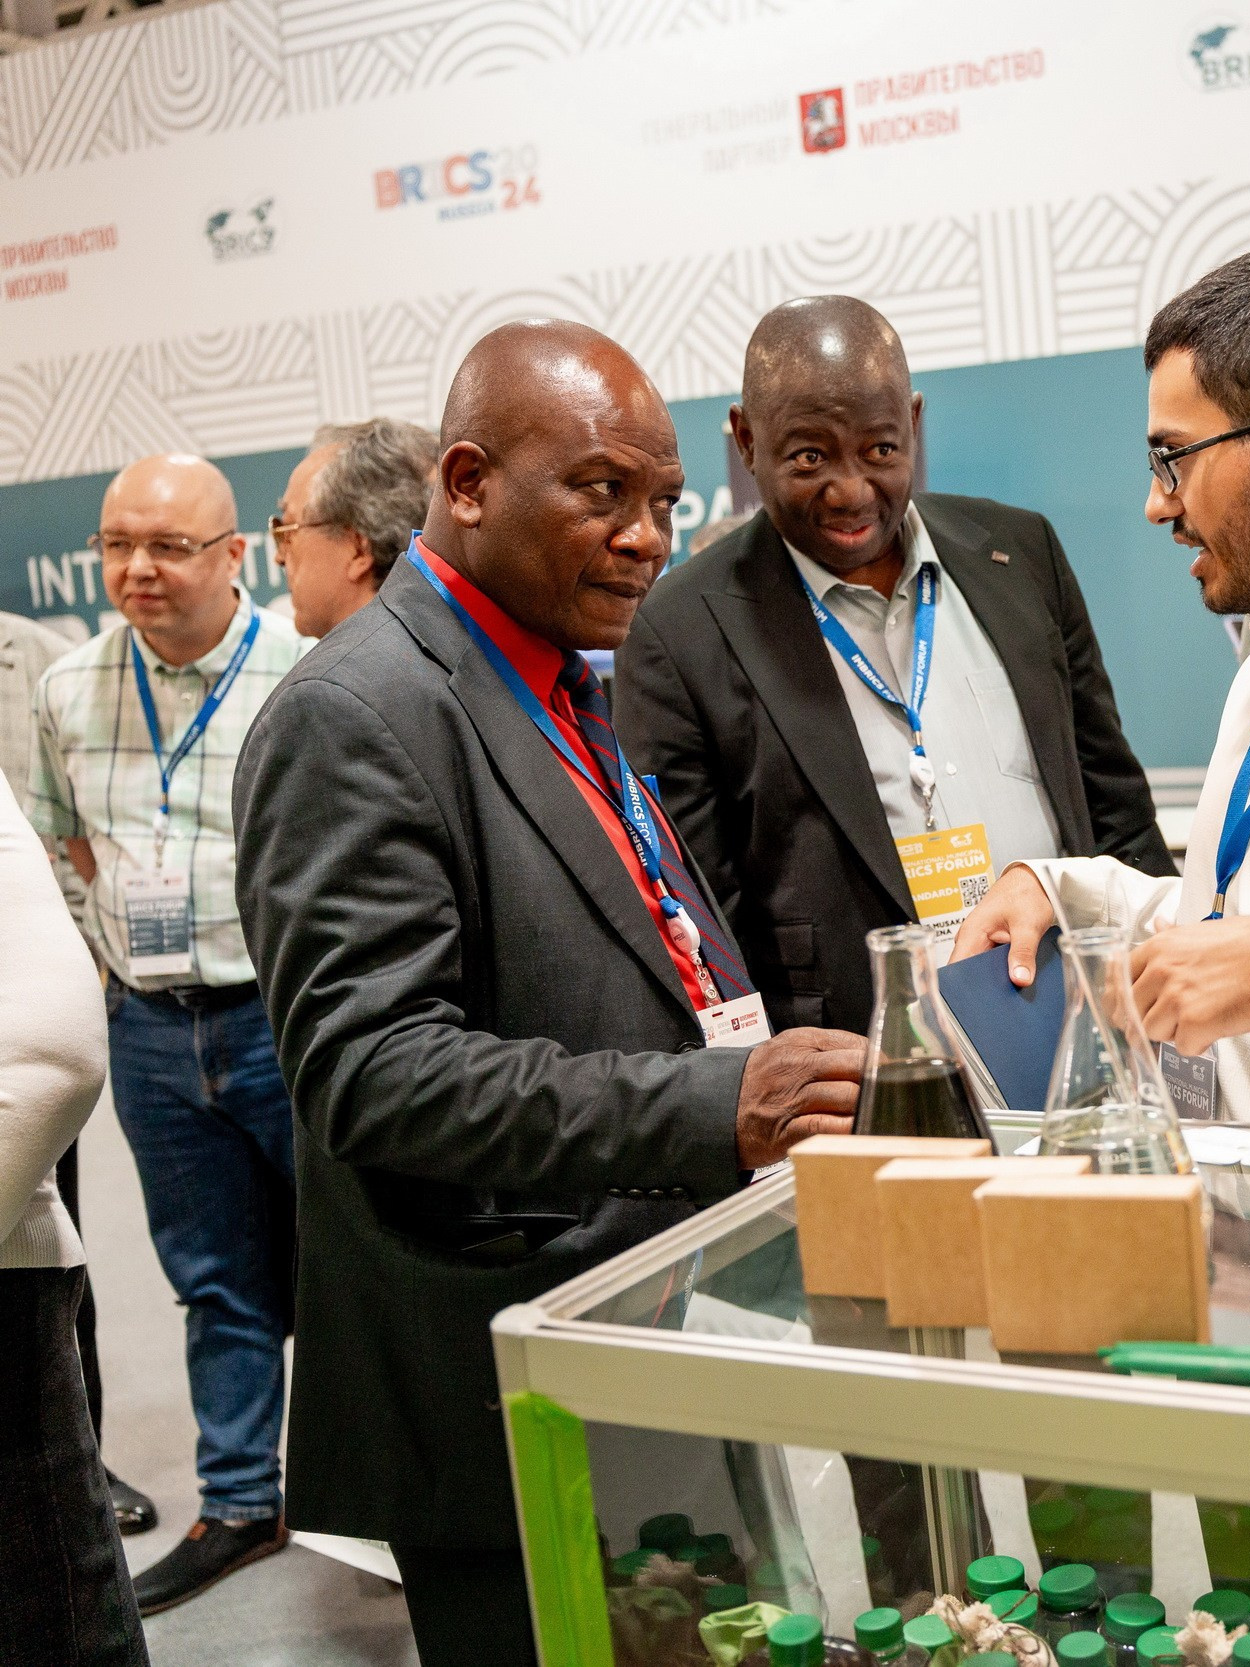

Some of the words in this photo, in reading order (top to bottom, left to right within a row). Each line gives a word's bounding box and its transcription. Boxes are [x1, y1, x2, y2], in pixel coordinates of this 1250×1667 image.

[625, 772, 646, 821] IMBRICS
[904, 864, 933, 879] RICS
[936, 854, 986, 874] FORUM
[1167, 1081, 1182, 1100] RICS
[1182, 1088, 1210, 1112] FORUM
